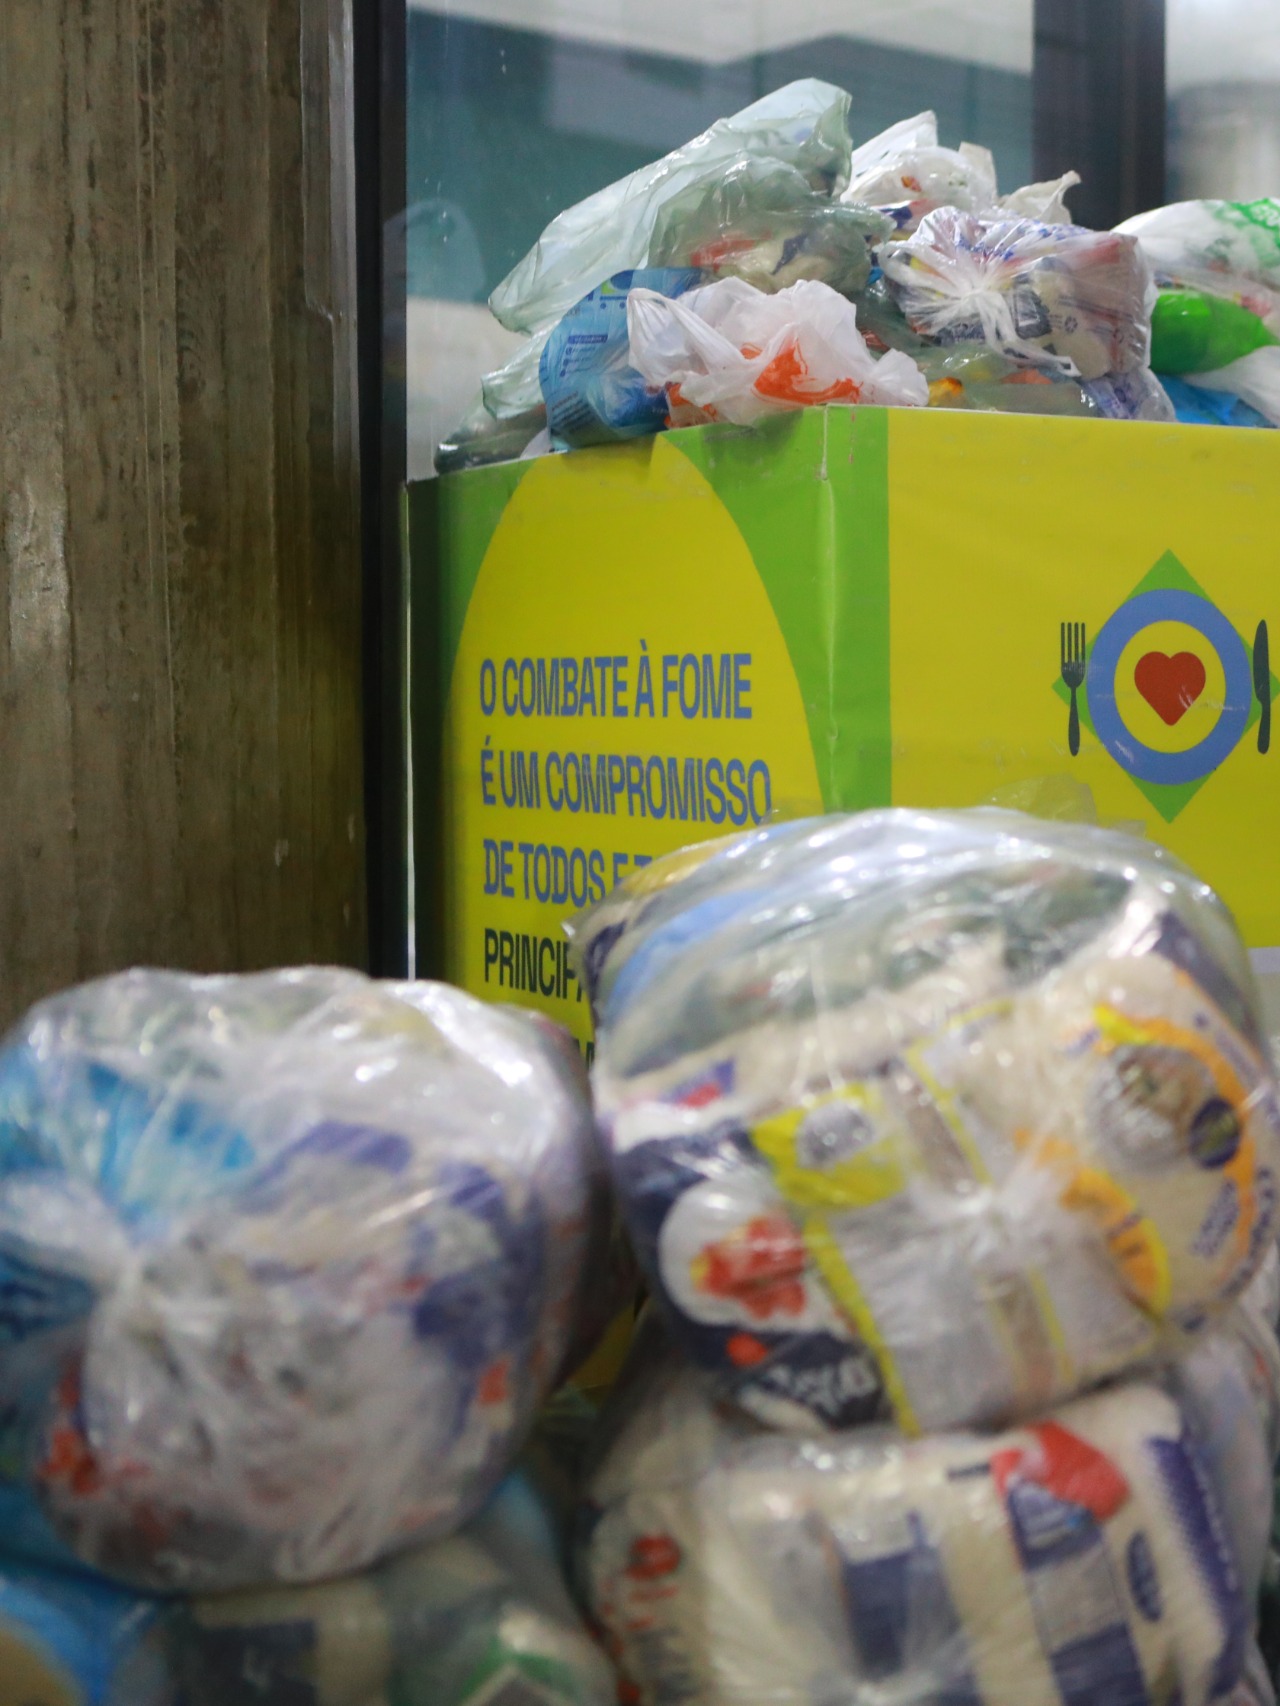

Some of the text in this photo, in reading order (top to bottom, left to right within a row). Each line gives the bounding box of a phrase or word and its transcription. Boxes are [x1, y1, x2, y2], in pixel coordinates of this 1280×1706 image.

[480, 639, 752, 719] O COMBATE À FOME
[481, 735, 772, 826] É UM COMPROMISSO
[483, 838, 515, 898] DE
[518, 842, 607, 908] TODOS
[484, 928, 583, 1002] PRINCIP
